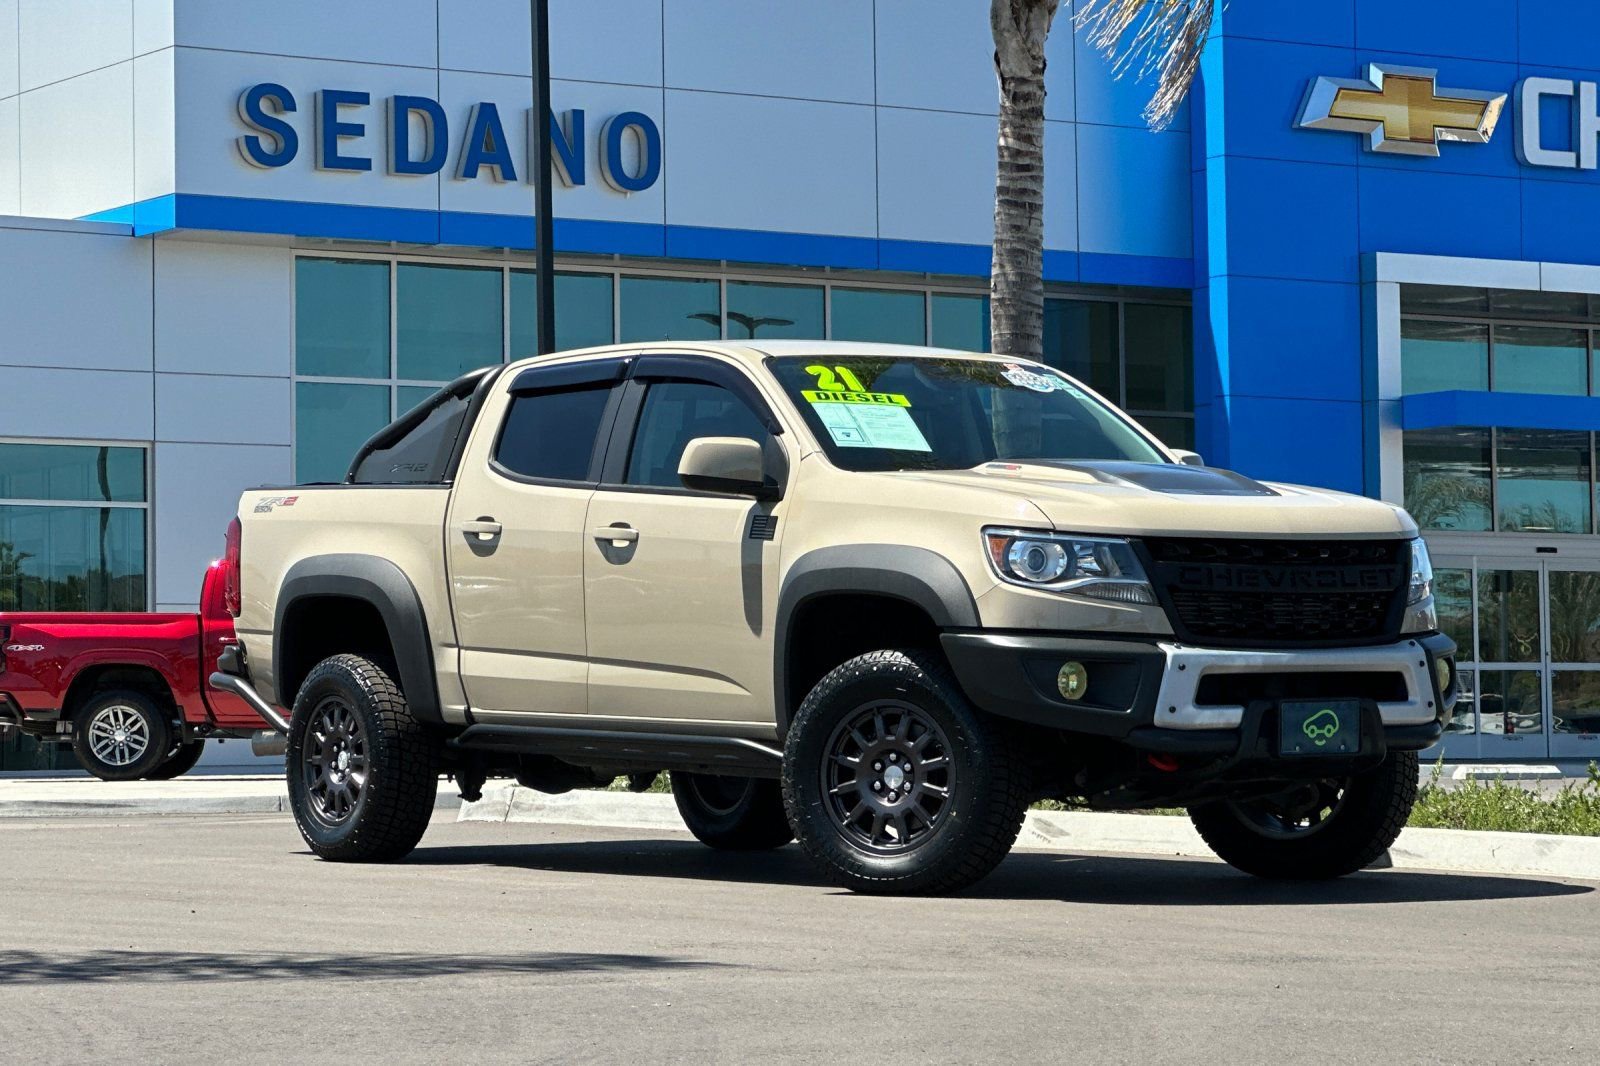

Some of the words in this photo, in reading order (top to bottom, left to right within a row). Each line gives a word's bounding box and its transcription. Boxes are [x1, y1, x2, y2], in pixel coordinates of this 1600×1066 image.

[238, 82, 662, 194] SEDANO
[804, 365, 866, 393] 21
[815, 391, 901, 405] DIESEL
[257, 496, 299, 506] ZR2
[1180, 566, 1396, 589] CHEVROLET
